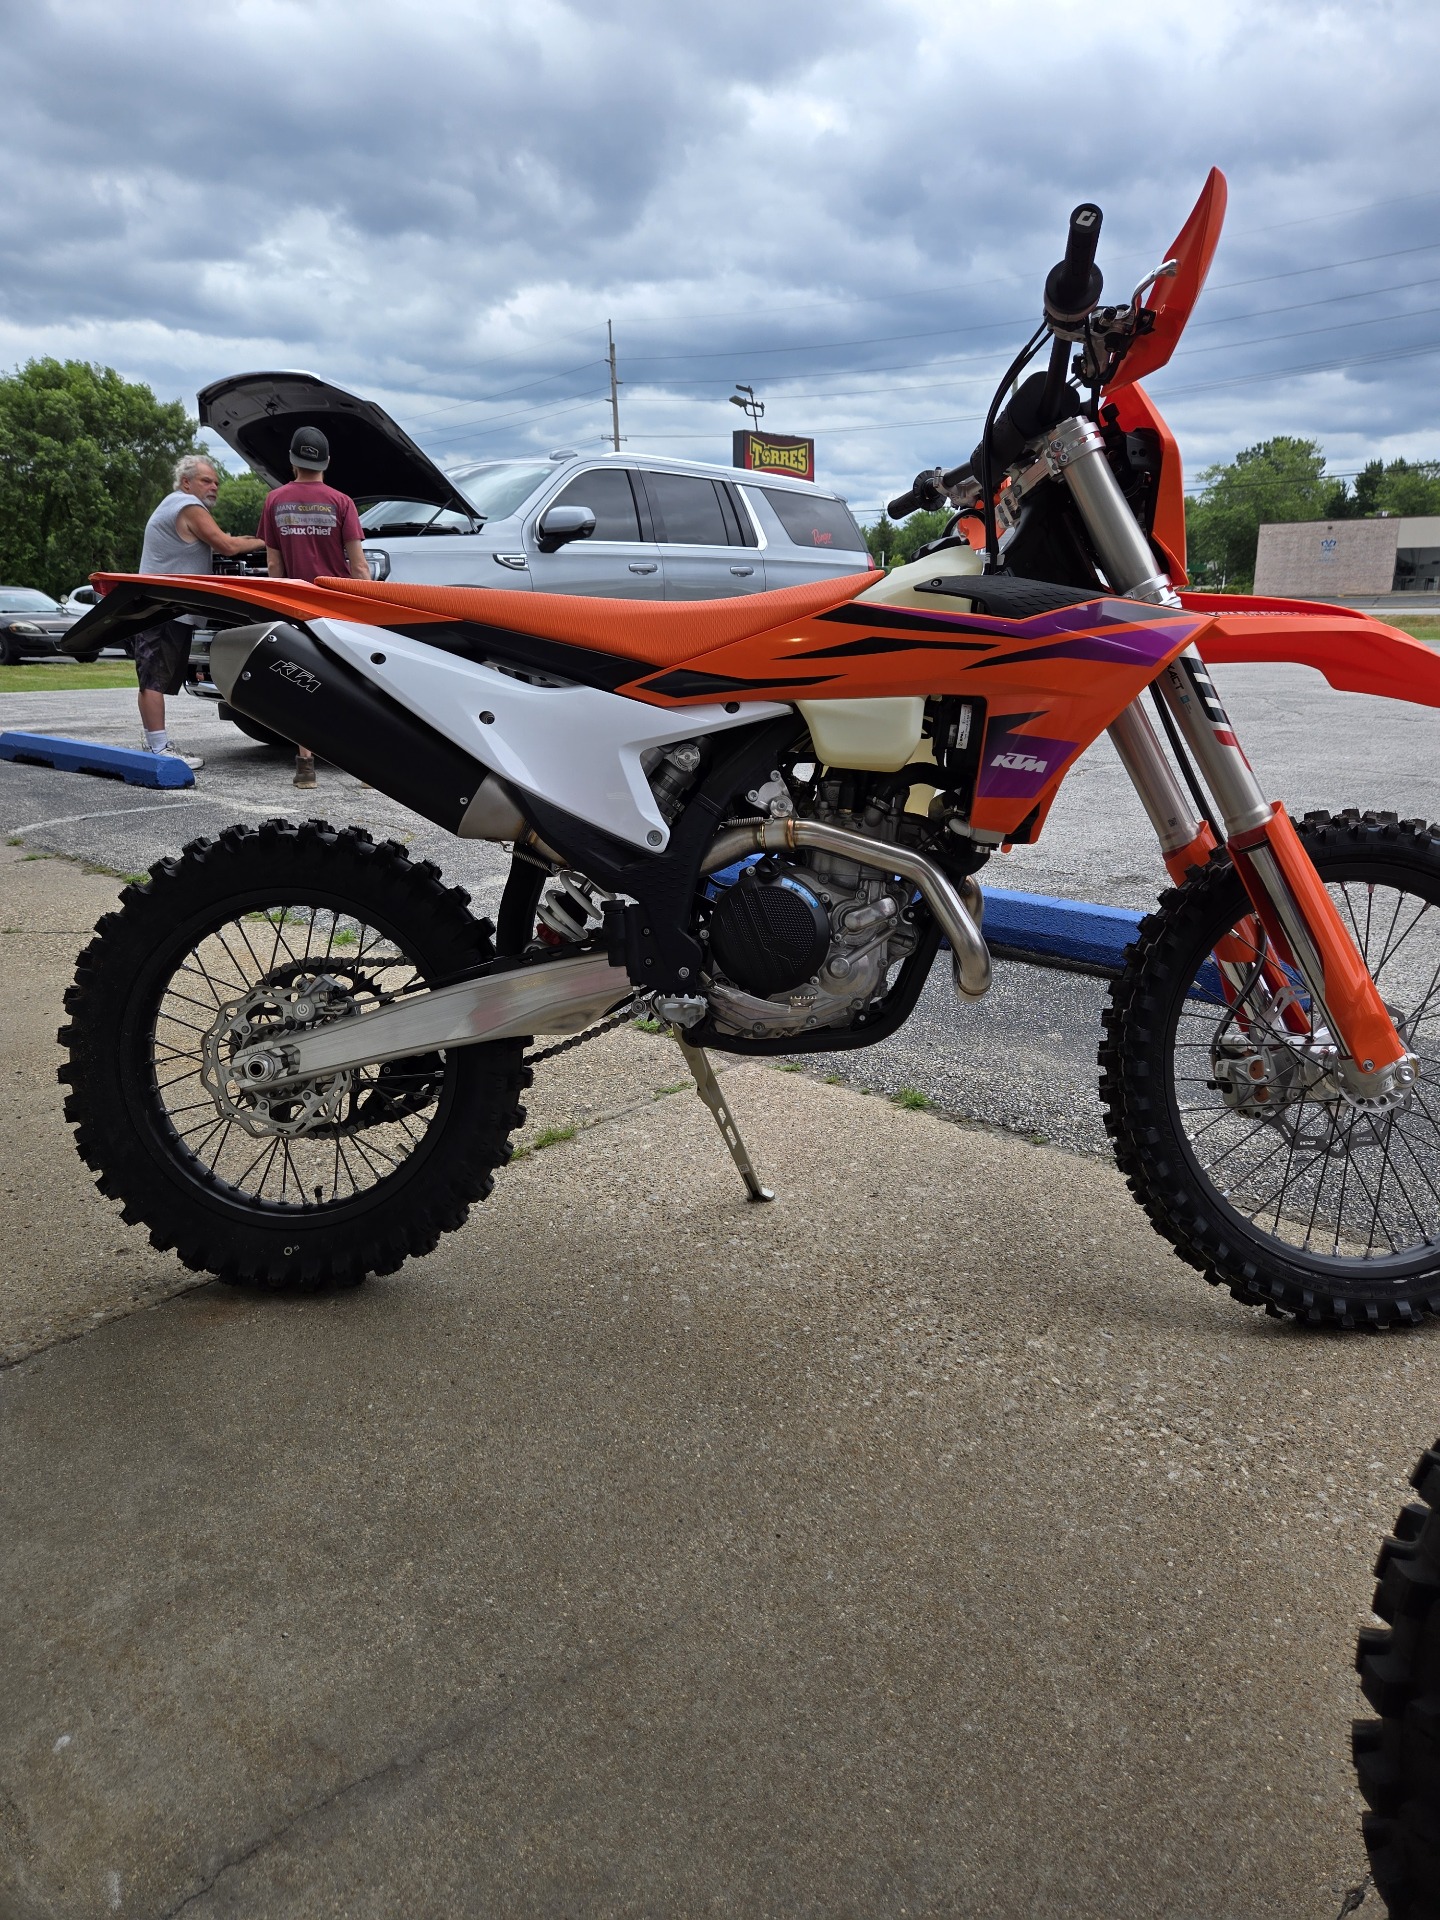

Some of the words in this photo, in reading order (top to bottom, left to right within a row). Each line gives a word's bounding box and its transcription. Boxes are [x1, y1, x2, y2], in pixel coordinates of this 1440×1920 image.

[751, 440, 807, 473] TORRES
[276, 504, 297, 512] MANY
[297, 504, 332, 512] SOLUTIONS
[280, 526, 306, 536] Sioux
[306, 525, 332, 536] Chief
[269, 659, 322, 693] KTM
[990, 752, 1048, 773] KTM
